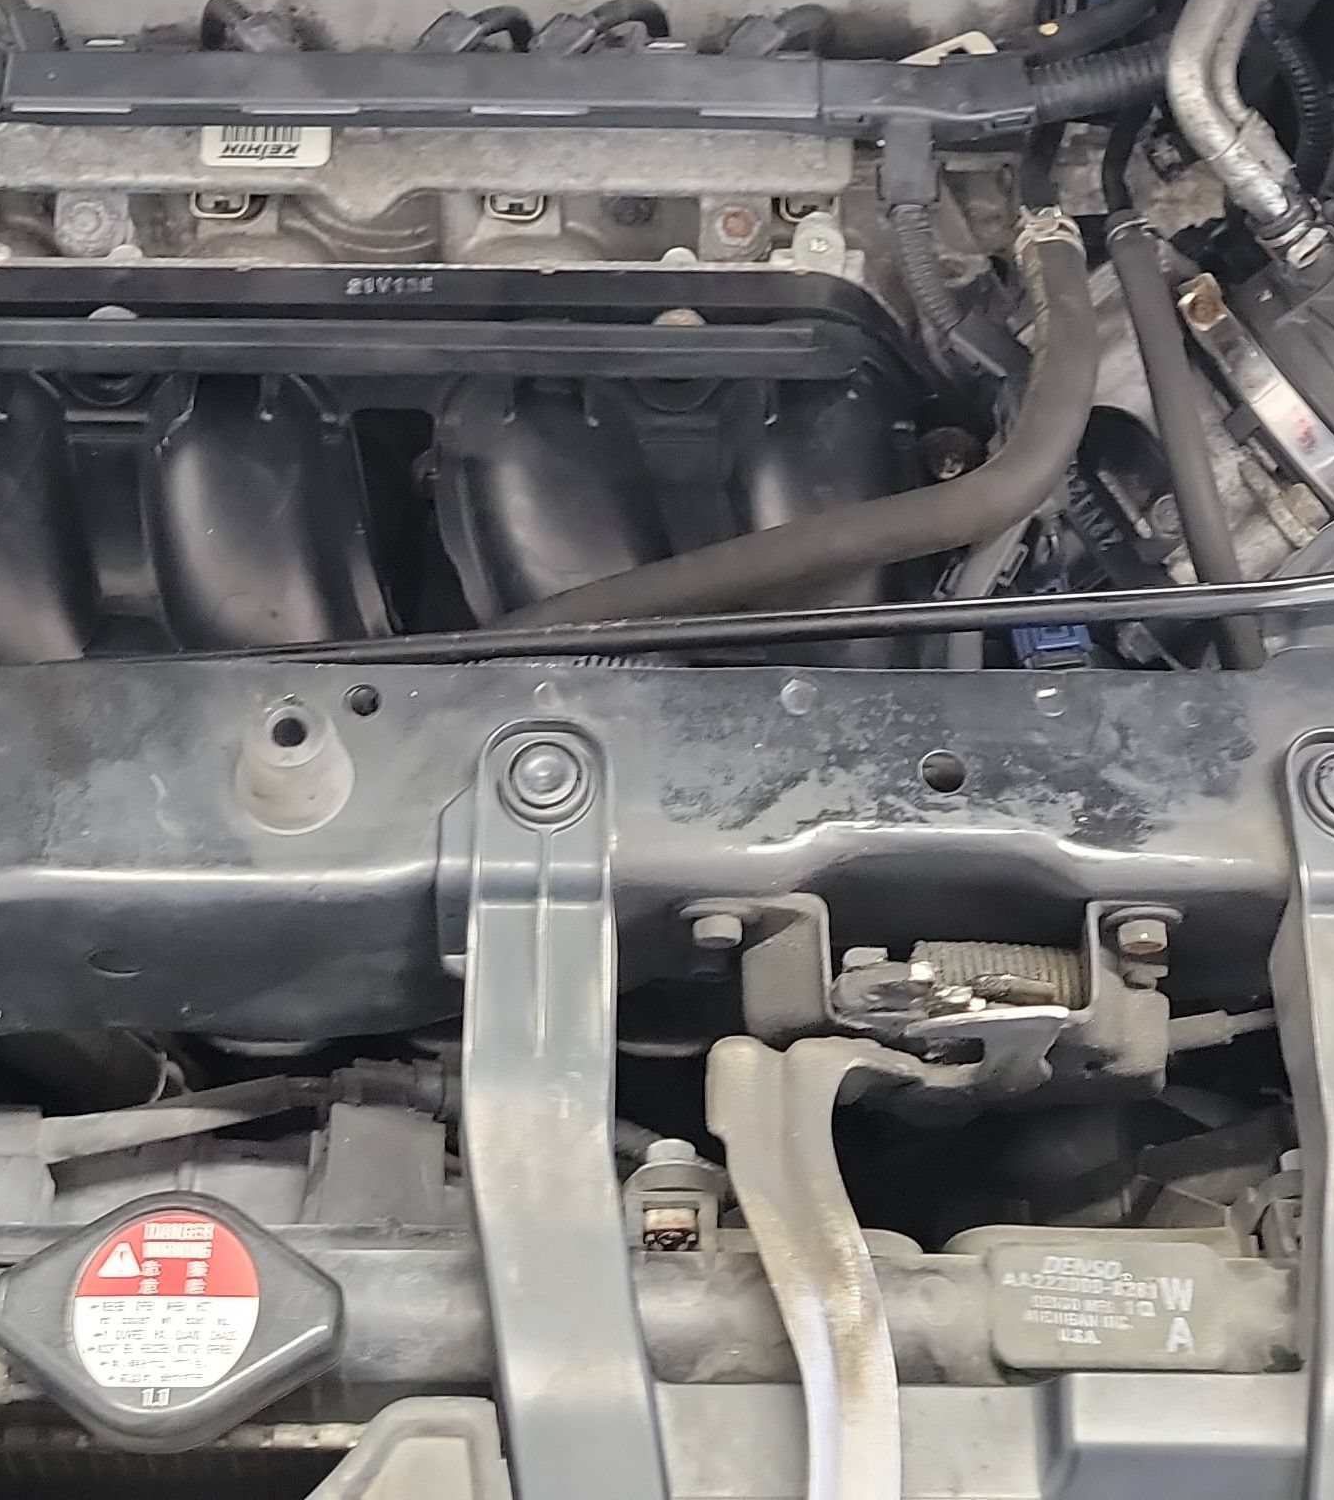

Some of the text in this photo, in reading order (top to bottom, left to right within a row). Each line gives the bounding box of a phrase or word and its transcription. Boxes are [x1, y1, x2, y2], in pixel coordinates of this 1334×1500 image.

[222, 143, 301, 157] KEIHIN
[1042, 1255, 1122, 1280] DENSO
[1158, 1277, 1194, 1312] W
[1165, 1316, 1195, 1355] A
